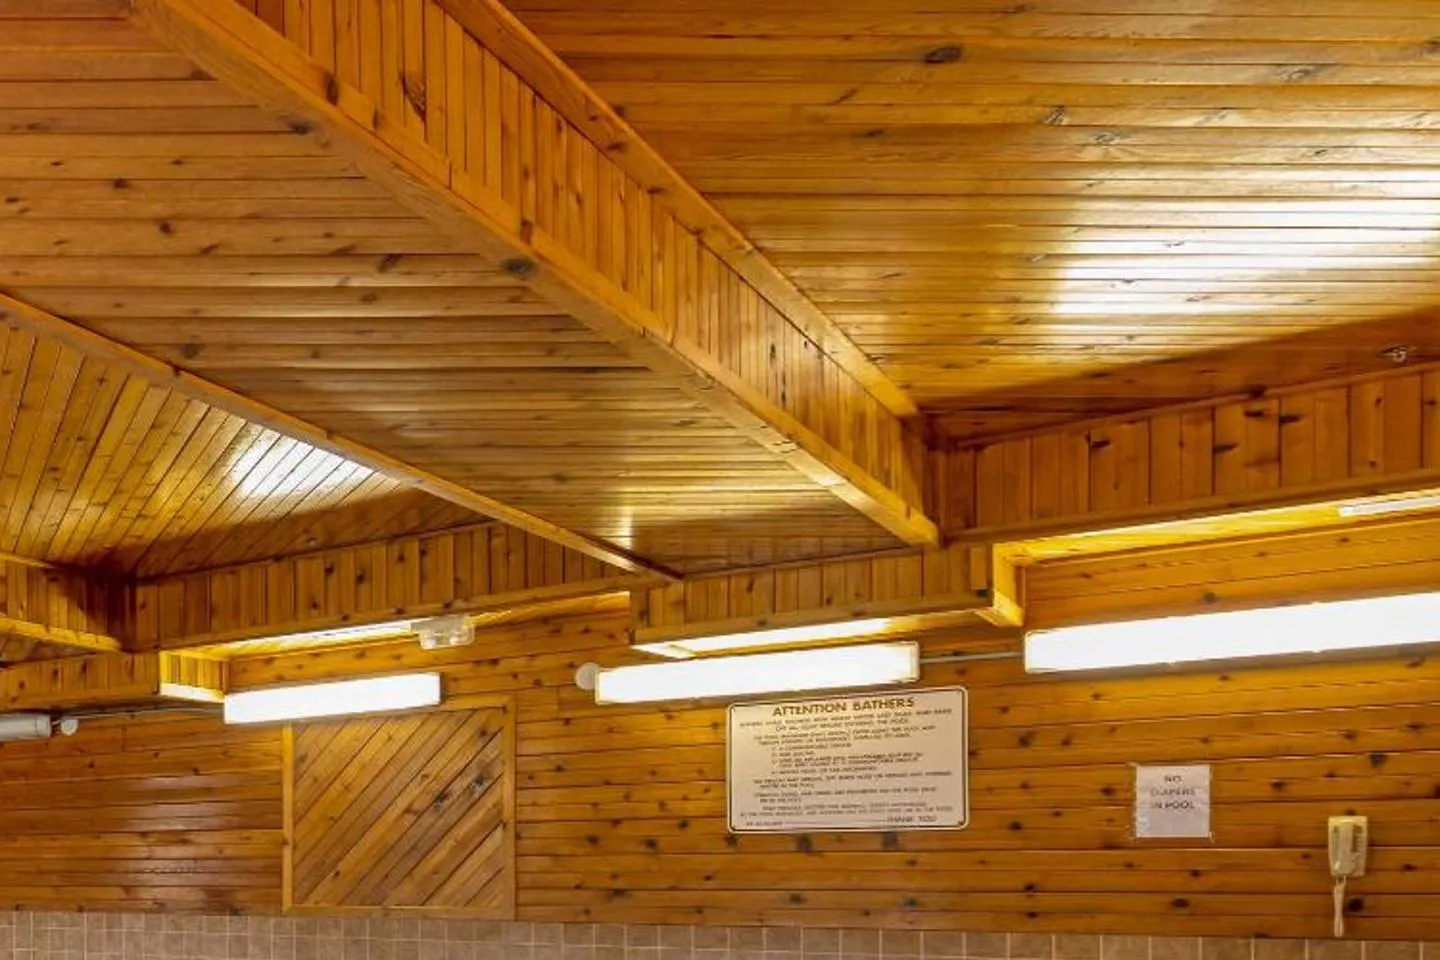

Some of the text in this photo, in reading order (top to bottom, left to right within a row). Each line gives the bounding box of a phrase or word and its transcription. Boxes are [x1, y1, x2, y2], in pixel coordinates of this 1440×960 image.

[772, 697, 915, 717] ATTENTION BATHERS
[1165, 800, 1195, 809] POOL
